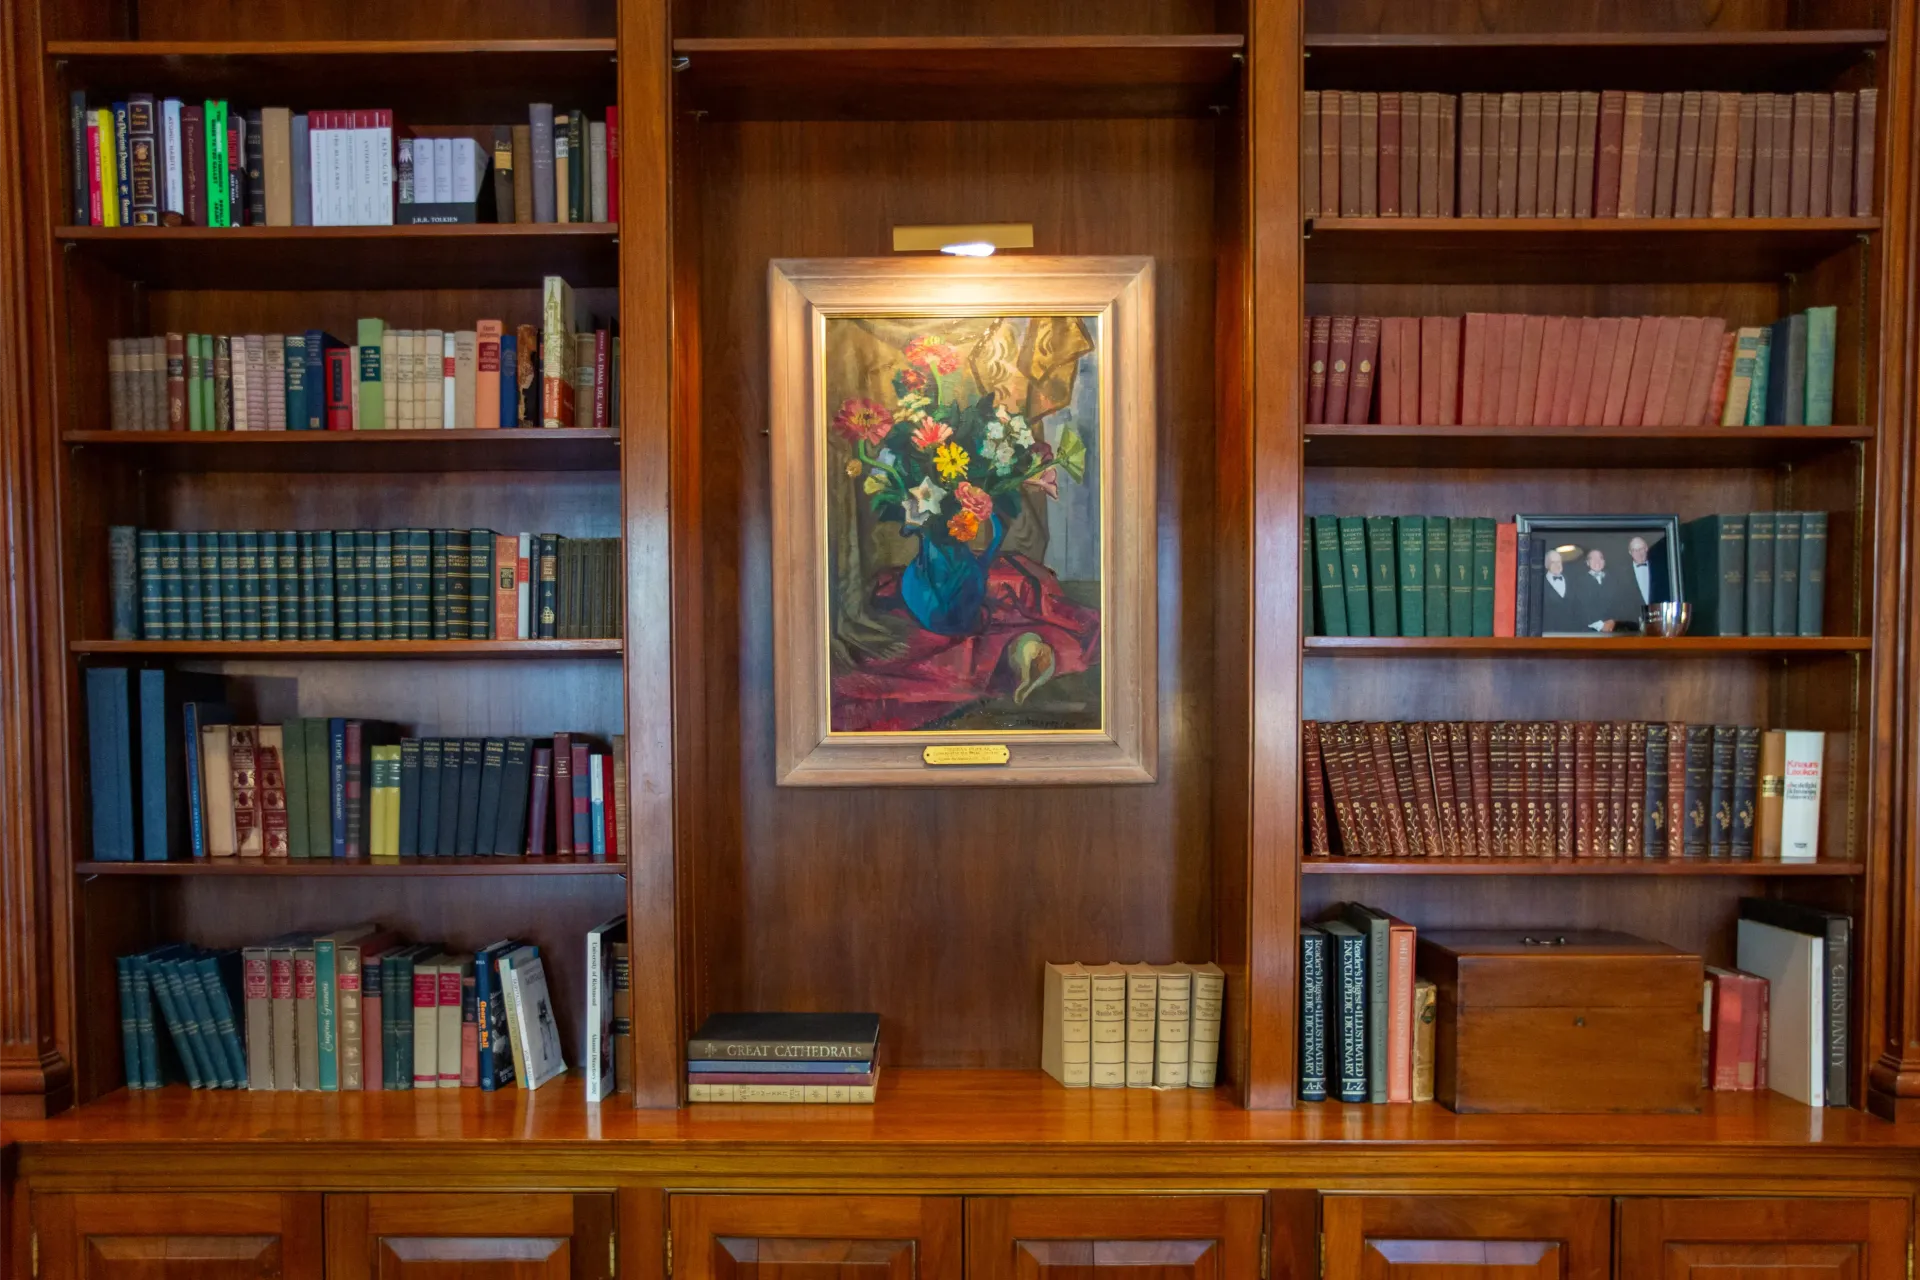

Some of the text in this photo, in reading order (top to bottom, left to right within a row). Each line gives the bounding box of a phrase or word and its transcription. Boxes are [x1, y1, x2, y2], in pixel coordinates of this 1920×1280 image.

[169, 146, 177, 171] HABITS
[598, 353, 605, 363] LA
[597, 364, 605, 384] DAMA
[1786, 768, 1819, 776] Lexikon
[1787, 760, 1819, 768] Knaurs
[590, 942, 598, 969] University
[1376, 931, 1385, 995] TWENTY DAYS
[591, 978, 599, 1007] Richmond
[1304, 940, 1314, 1075] ENCYCLOPEDIC DICTIONARY
[1312, 940, 1324, 1076] Reader's Digest ILLUSTRATED
[1344, 940, 1354, 1075] ENCYCLOPEDIC DICTIONARY
[1351, 940, 1364, 1076] Reader's Digest ILLUSTRATED
[1831, 964, 1845, 1069] CHRISTIANITY
[479, 1001, 490, 1049] George Ball
[590, 1033, 599, 1079] Alumni Directory
[727, 1044, 862, 1058] GREAT CATHEDRALS
[1306, 1081, 1324, 1090] A-K
[1345, 1082, 1364, 1091] L-Z
